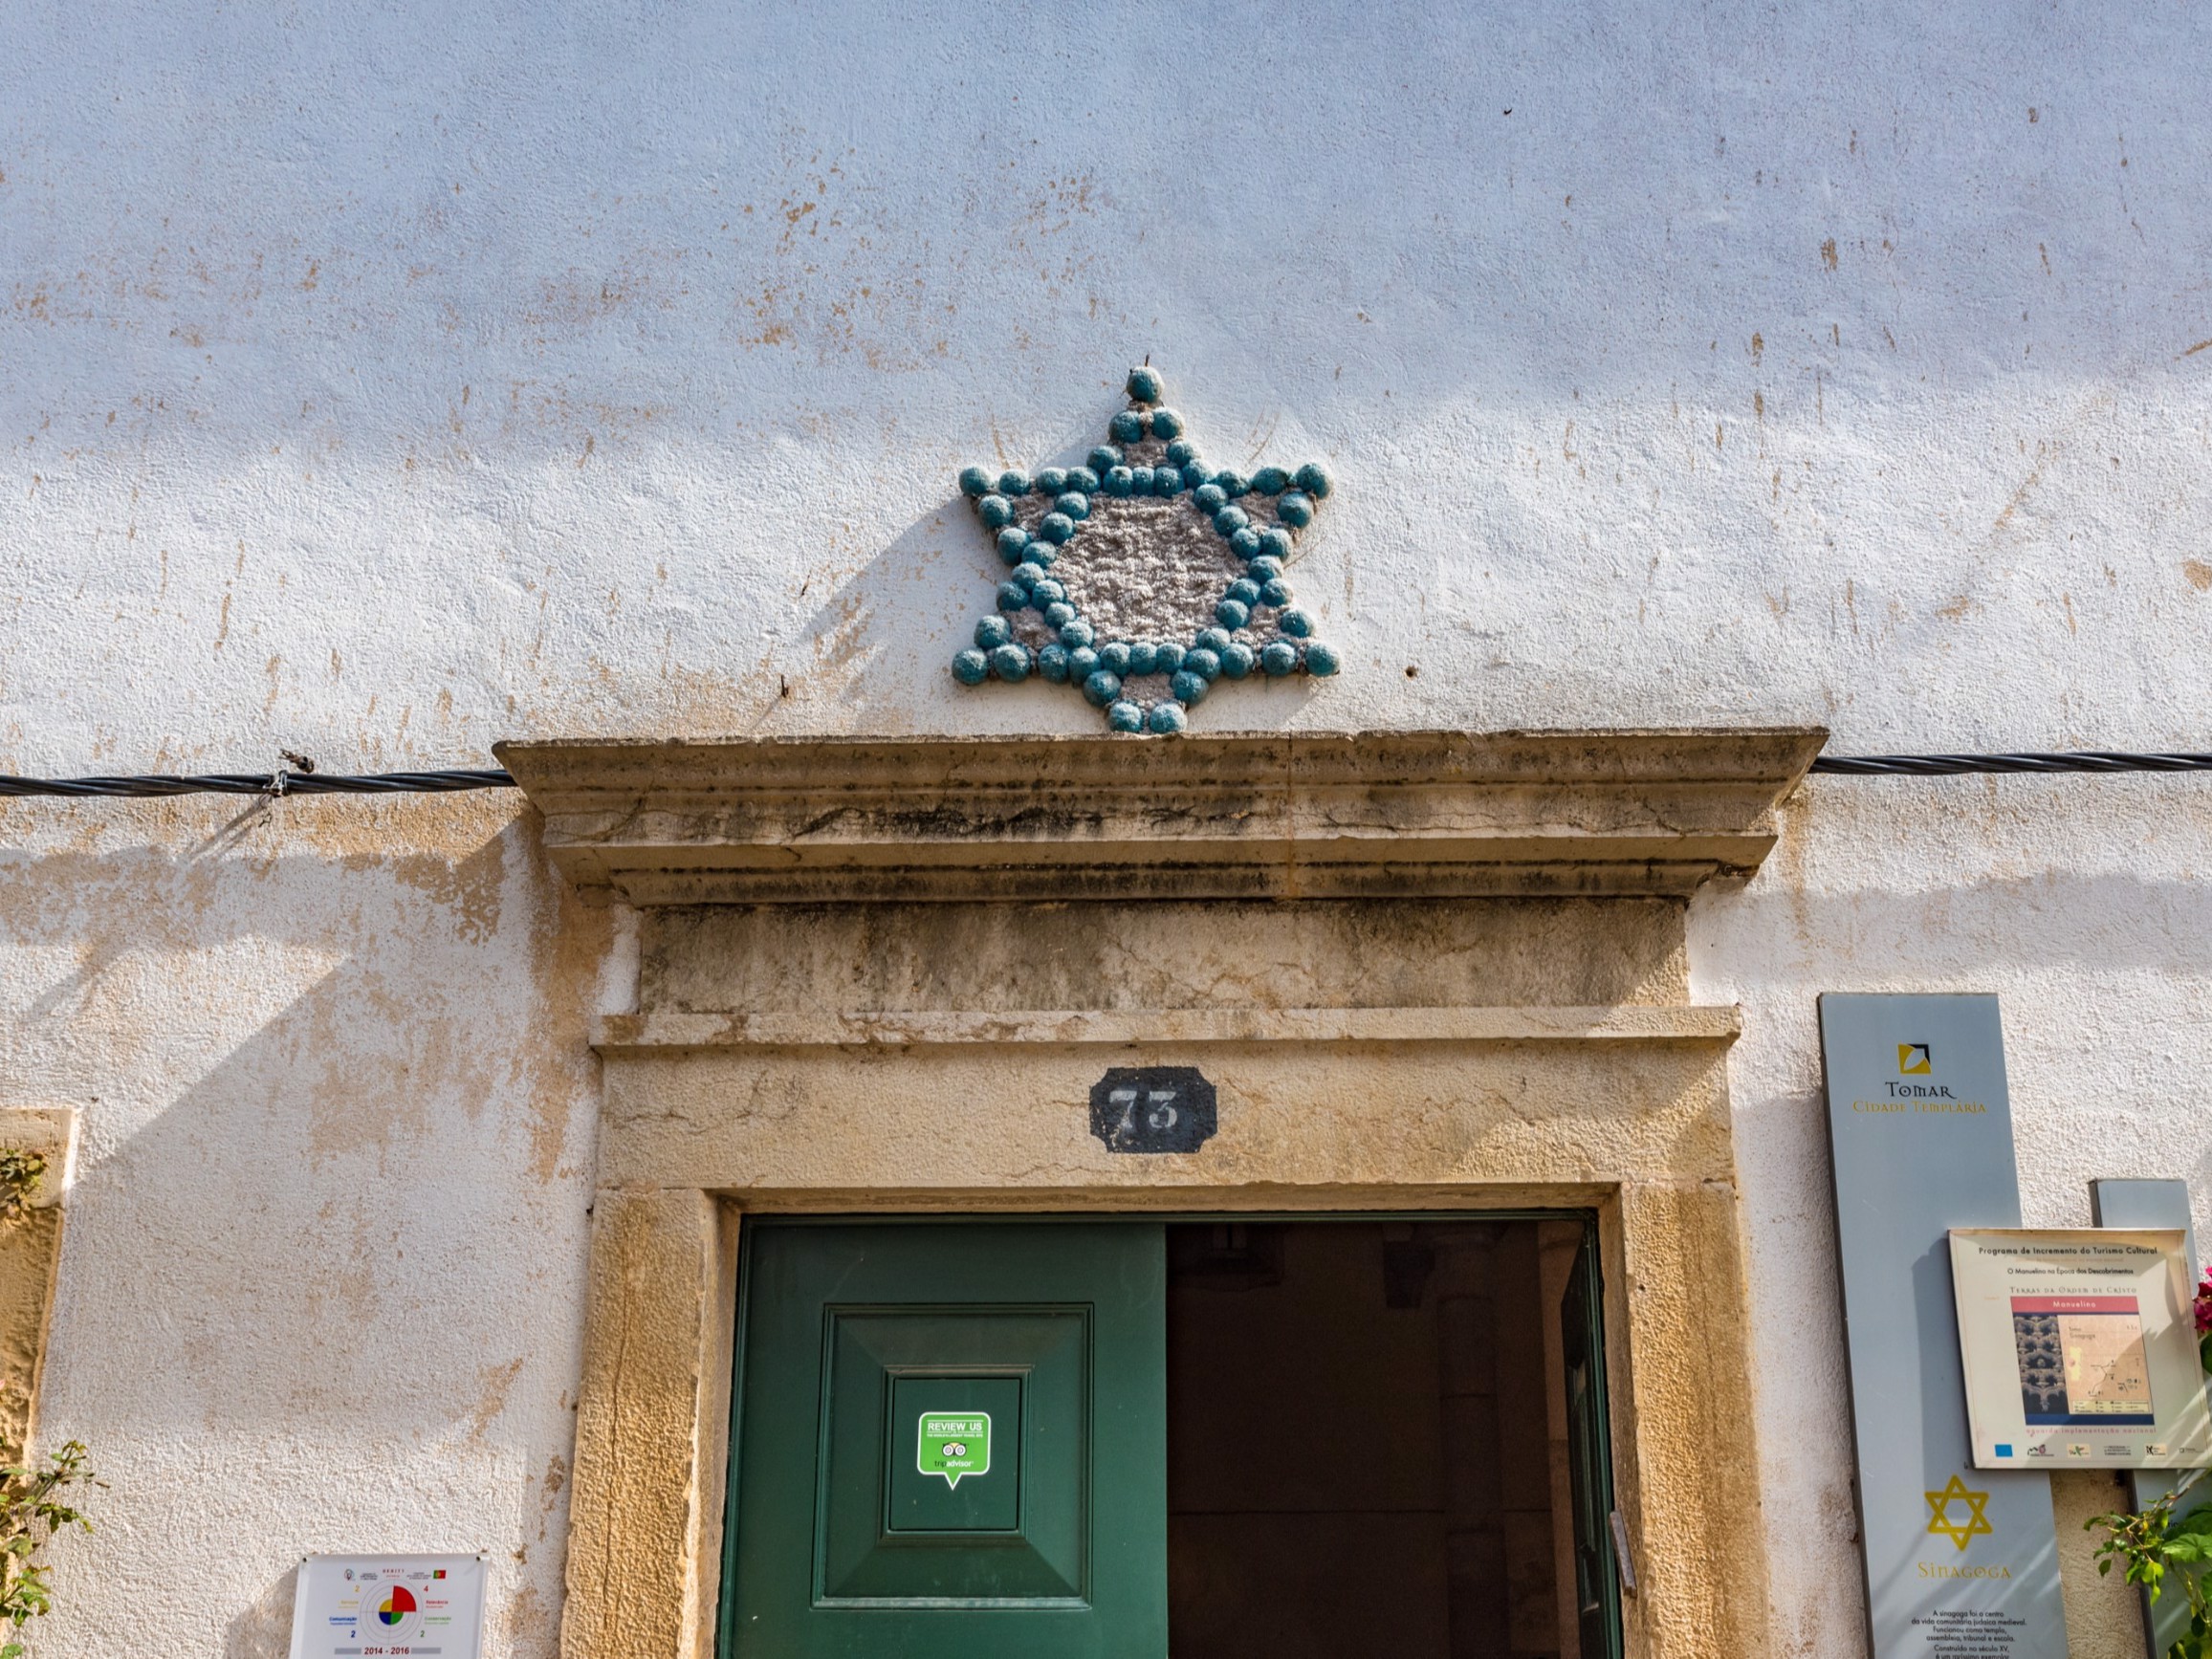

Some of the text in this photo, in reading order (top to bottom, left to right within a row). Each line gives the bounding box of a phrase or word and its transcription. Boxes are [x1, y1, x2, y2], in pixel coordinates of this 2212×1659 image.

[1108, 1089, 1178, 1129] 73
[1979, 1247, 2018, 1256] Programa
[2126, 1246, 2157, 1255] Cultural
[2057, 1266, 2074, 1276] Época
[928, 1422, 983, 1431] REVIEW US
[1939, 1610, 1968, 1619] sinagoga
[1937, 1617, 1972, 1626] comunitária
[1973, 1618, 1997, 1626] judaica
[364, 1647, 383, 1655] 2014
[390, 1647, 410, 1655] 2016
